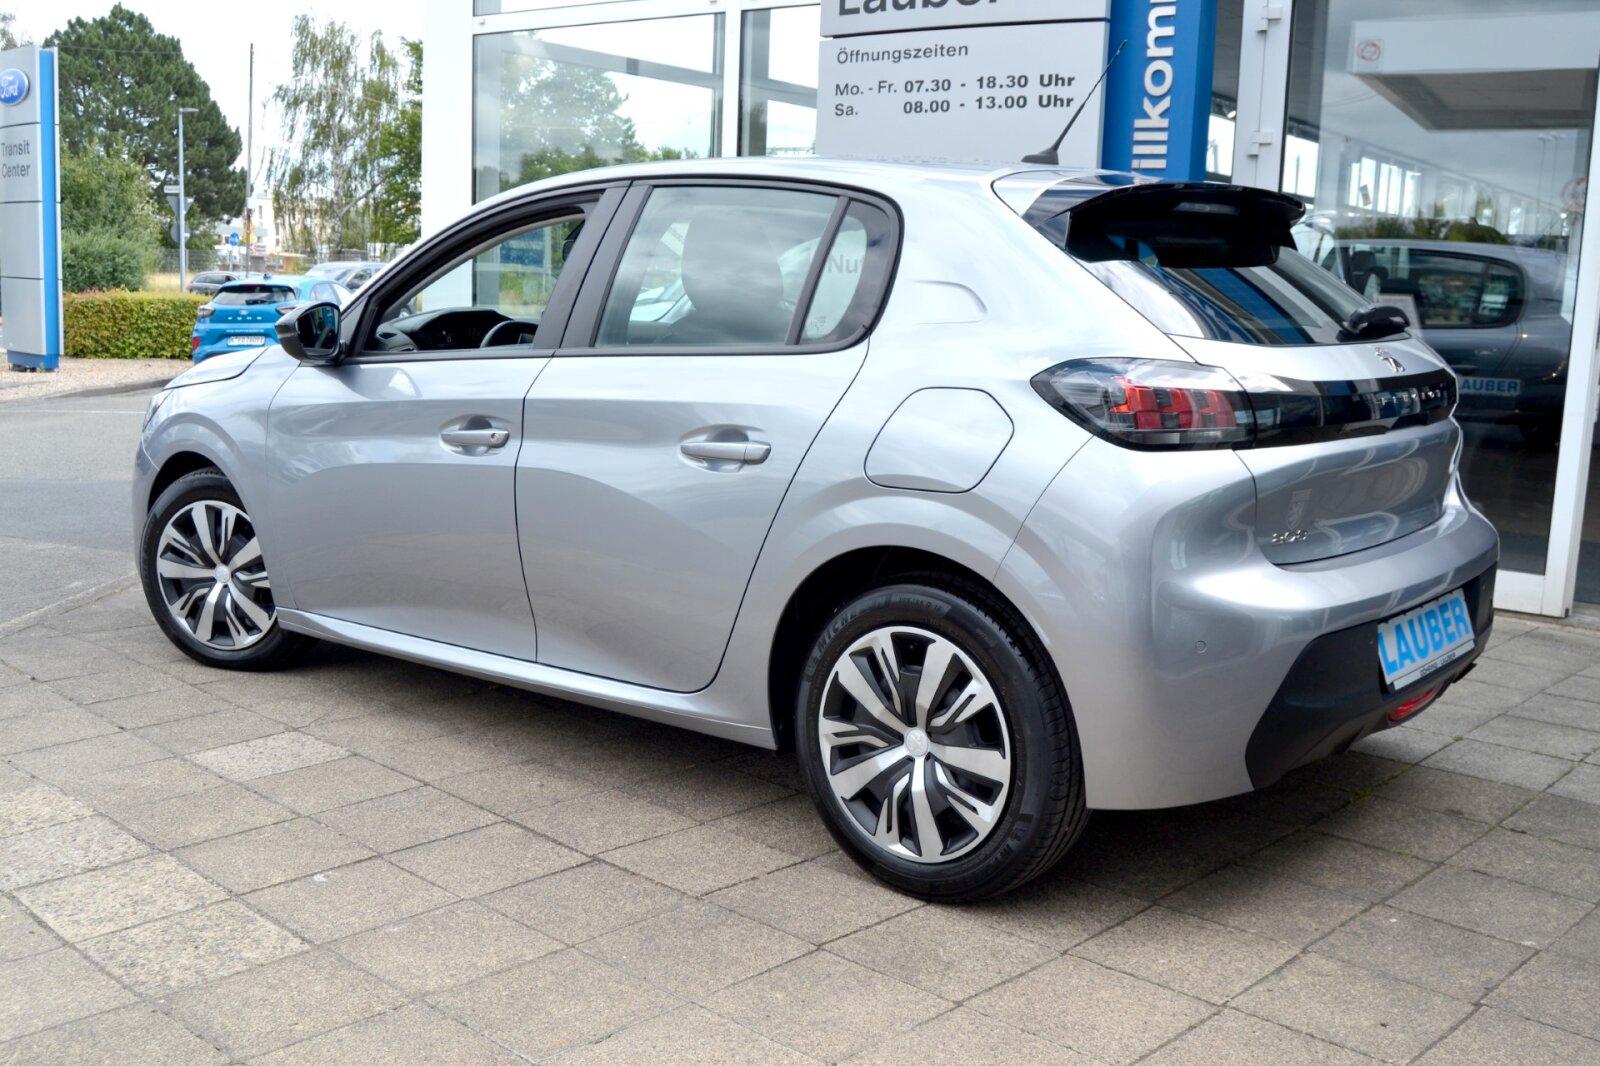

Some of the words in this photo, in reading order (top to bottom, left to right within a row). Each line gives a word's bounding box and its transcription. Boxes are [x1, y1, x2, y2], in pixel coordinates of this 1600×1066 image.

[837, 45, 969, 64] Öffnungszeiten
[835, 83, 864, 96] Mo.
[878, 80, 897, 94] Fr.
[904, 79, 951, 93] 07.30
[977, 75, 1029, 89] 18.30
[1039, 74, 1075, 88] Uhr
[835, 103, 859, 116] Sa.
[903, 100, 951, 114] 08.00
[976, 96, 1028, 110] 13.00
[1038, 95, 1074, 108] Uhr
[1, 140, 31, 157] Transit
[1, 163, 31, 178] Center
[827, 254, 864, 273] Nu
[1459, 379, 1519, 393] AUBER
[1377, 596, 1471, 676] LAUBER
